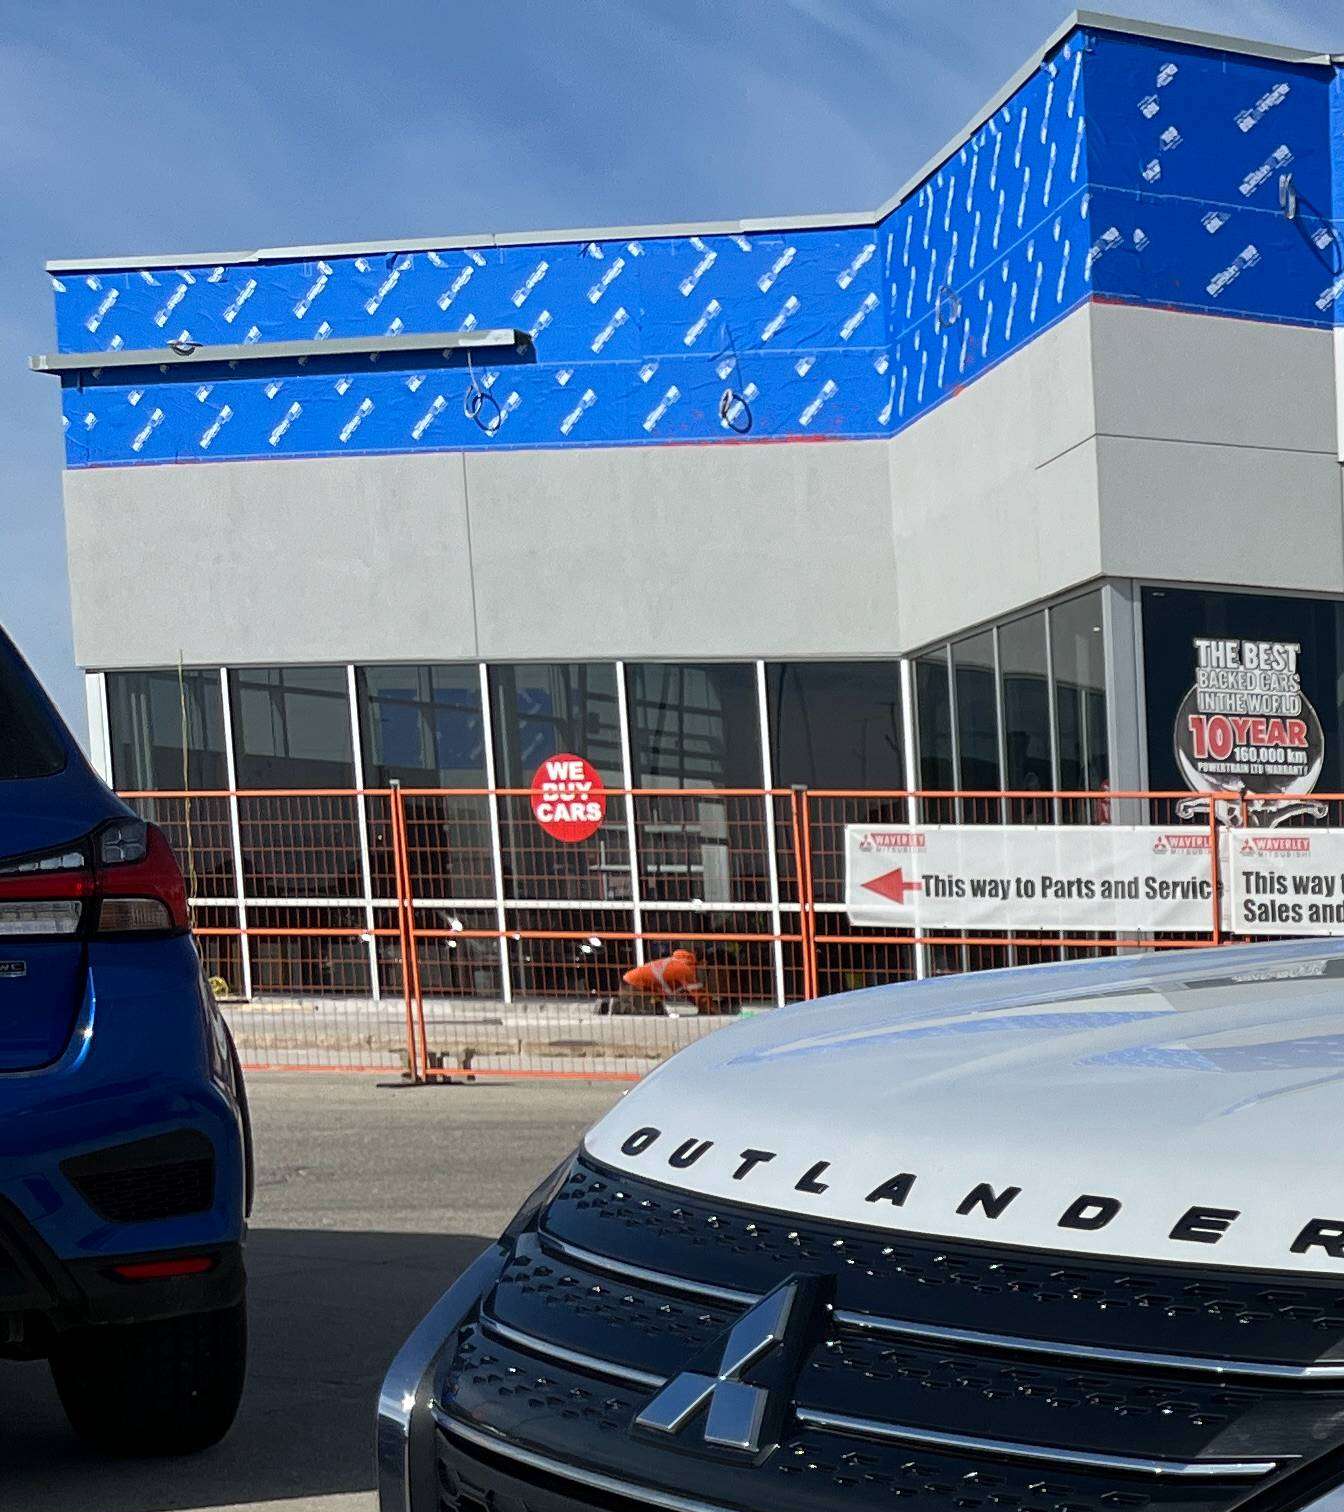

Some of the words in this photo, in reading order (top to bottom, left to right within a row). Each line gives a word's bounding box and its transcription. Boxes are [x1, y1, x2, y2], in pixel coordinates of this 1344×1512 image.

[1194, 638, 1240, 669] THE
[1243, 640, 1301, 673] BEST
[1198, 669, 1258, 691] BACKED
[1199, 692, 1217, 711] IN
[1217, 693, 1247, 713] THE
[1248, 694, 1302, 716] WORLD
[1188, 714, 1233, 760] 10
[1230, 716, 1309, 748] YEAR
[1287, 751, 1308, 764] km
[546, 761, 585, 780] WE
[542, 782, 592, 801] BUY
[536, 802, 602, 823] CARS
[1168, 836, 1212, 848] WAVERL
[1255, 839, 1309, 850] WAVERLEY
[923, 874, 965, 899] This
[971, 878, 1011, 902] way
[1015, 877, 1037, 899] to
[1042, 875, 1096, 900] Parts
[1101, 876, 1140, 900] and
[1242, 871, 1288, 895] This
[1292, 874, 1335, 898] way
[1243, 899, 1306, 924] Sales
